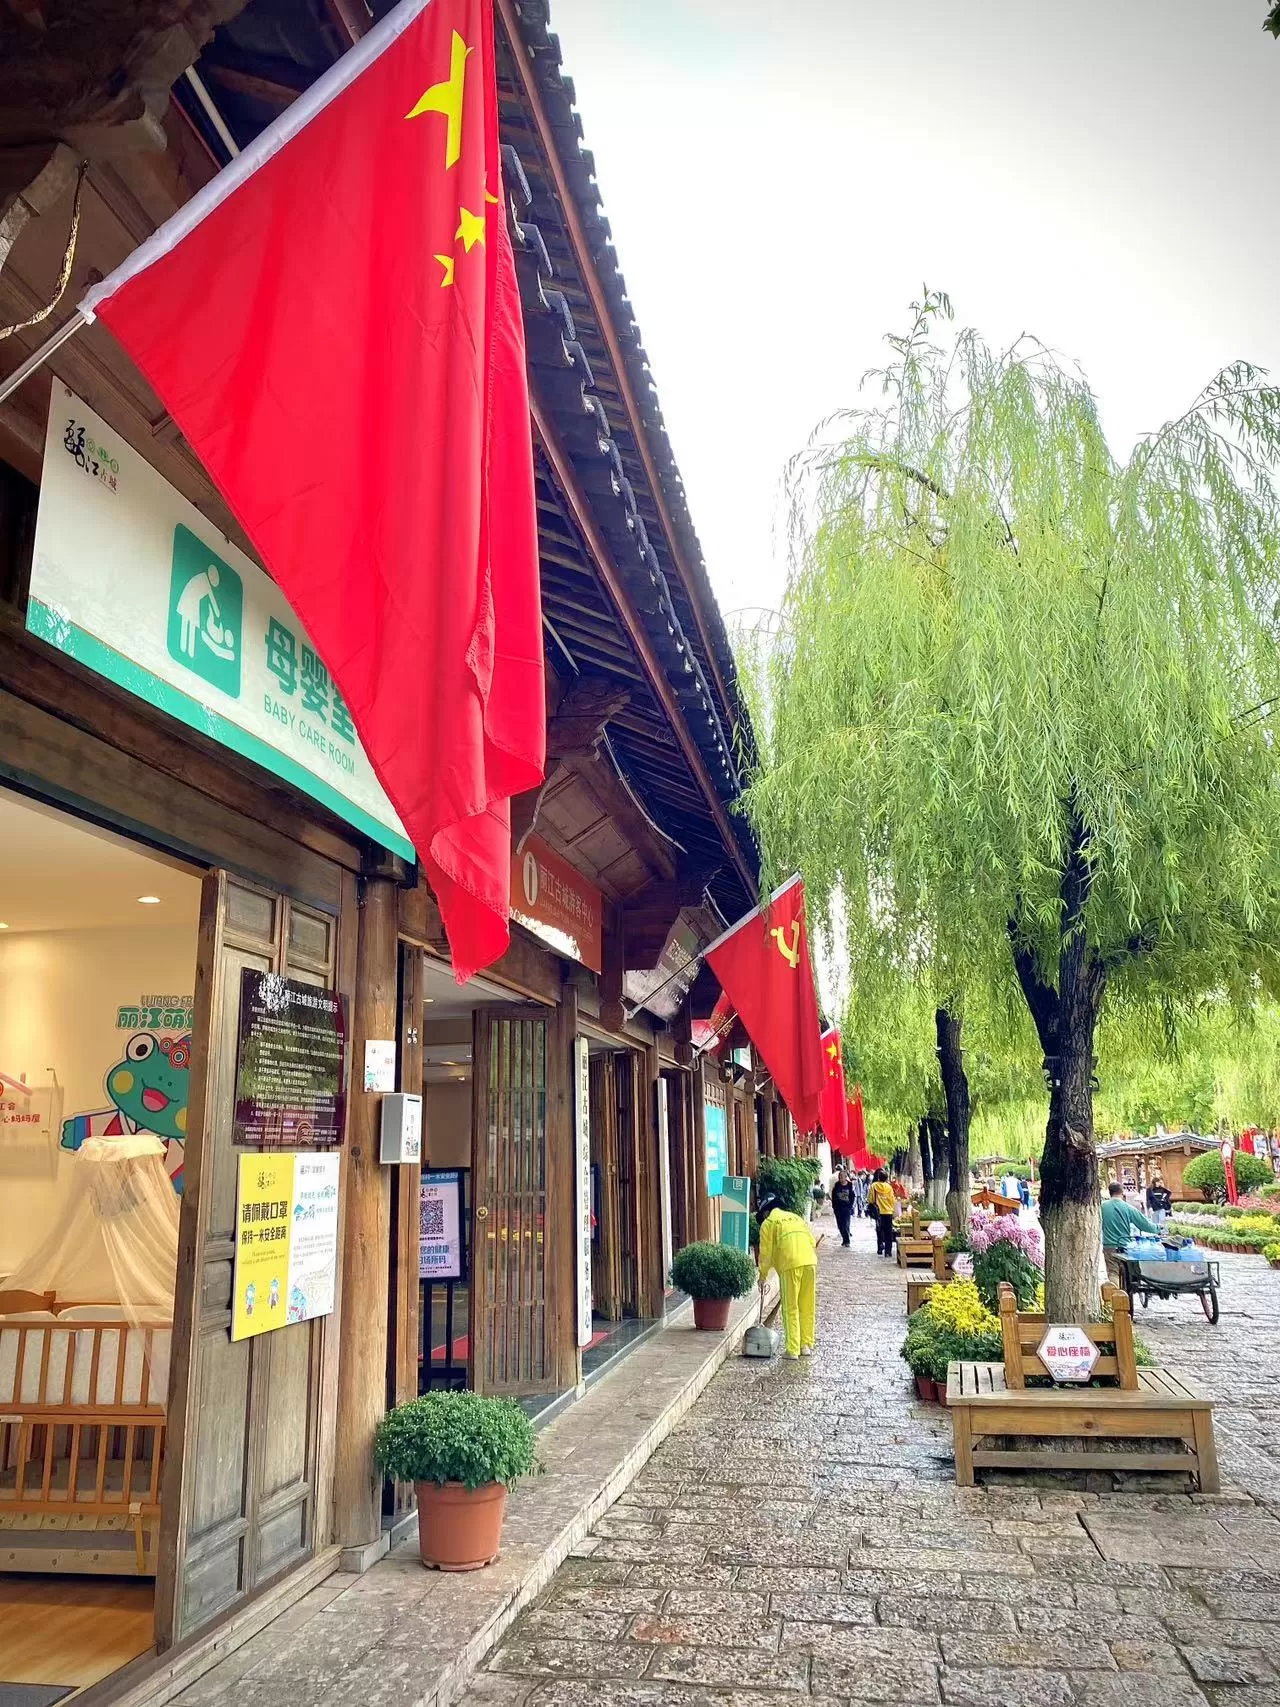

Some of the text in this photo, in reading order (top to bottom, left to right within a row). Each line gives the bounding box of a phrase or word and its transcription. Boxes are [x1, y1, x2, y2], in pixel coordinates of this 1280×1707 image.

[265, 616, 355, 746] 母婴室
[264, 694, 355, 777] BABY CARE ROOM
[242, 1201, 288, 1223] 请佩戴口罩
[242, 1226, 287, 1245] 保持一米安全距离
[1047, 1346, 1091, 1357] 爱心座椅
